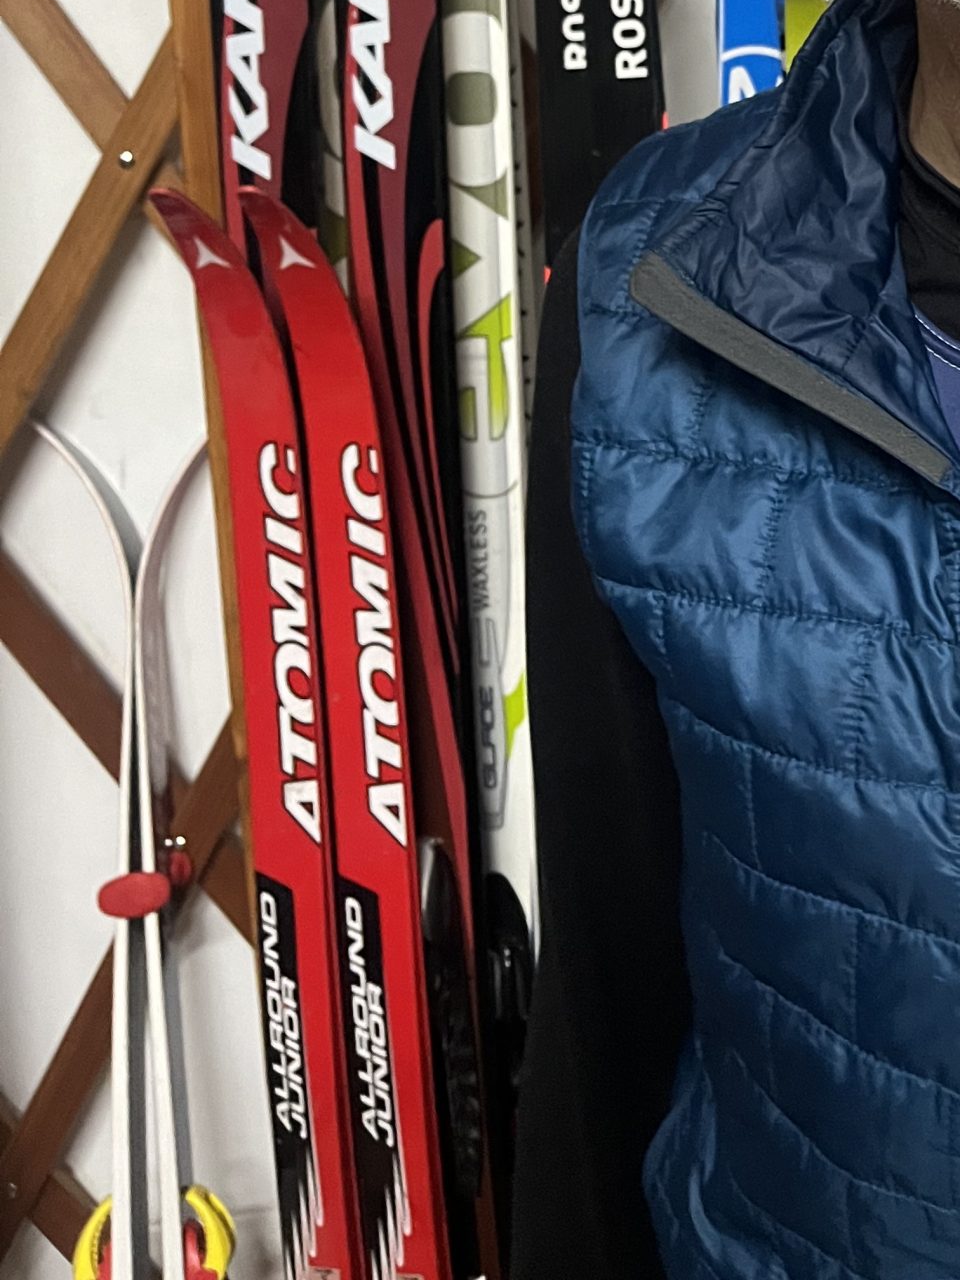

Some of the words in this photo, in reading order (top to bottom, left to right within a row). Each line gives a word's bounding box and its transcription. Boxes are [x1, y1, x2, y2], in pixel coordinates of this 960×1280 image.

[258, 441, 322, 845] ATOMIC
[340, 442, 407, 848] ATOMIC
[468, 509, 490, 611] WAXLESS
[260, 892, 293, 1132] ALLROUND
[281, 977, 308, 1140] JUNIOR
[345, 896, 379, 1141] ALLROUND
[366, 982, 394, 1148] JUNIOR
